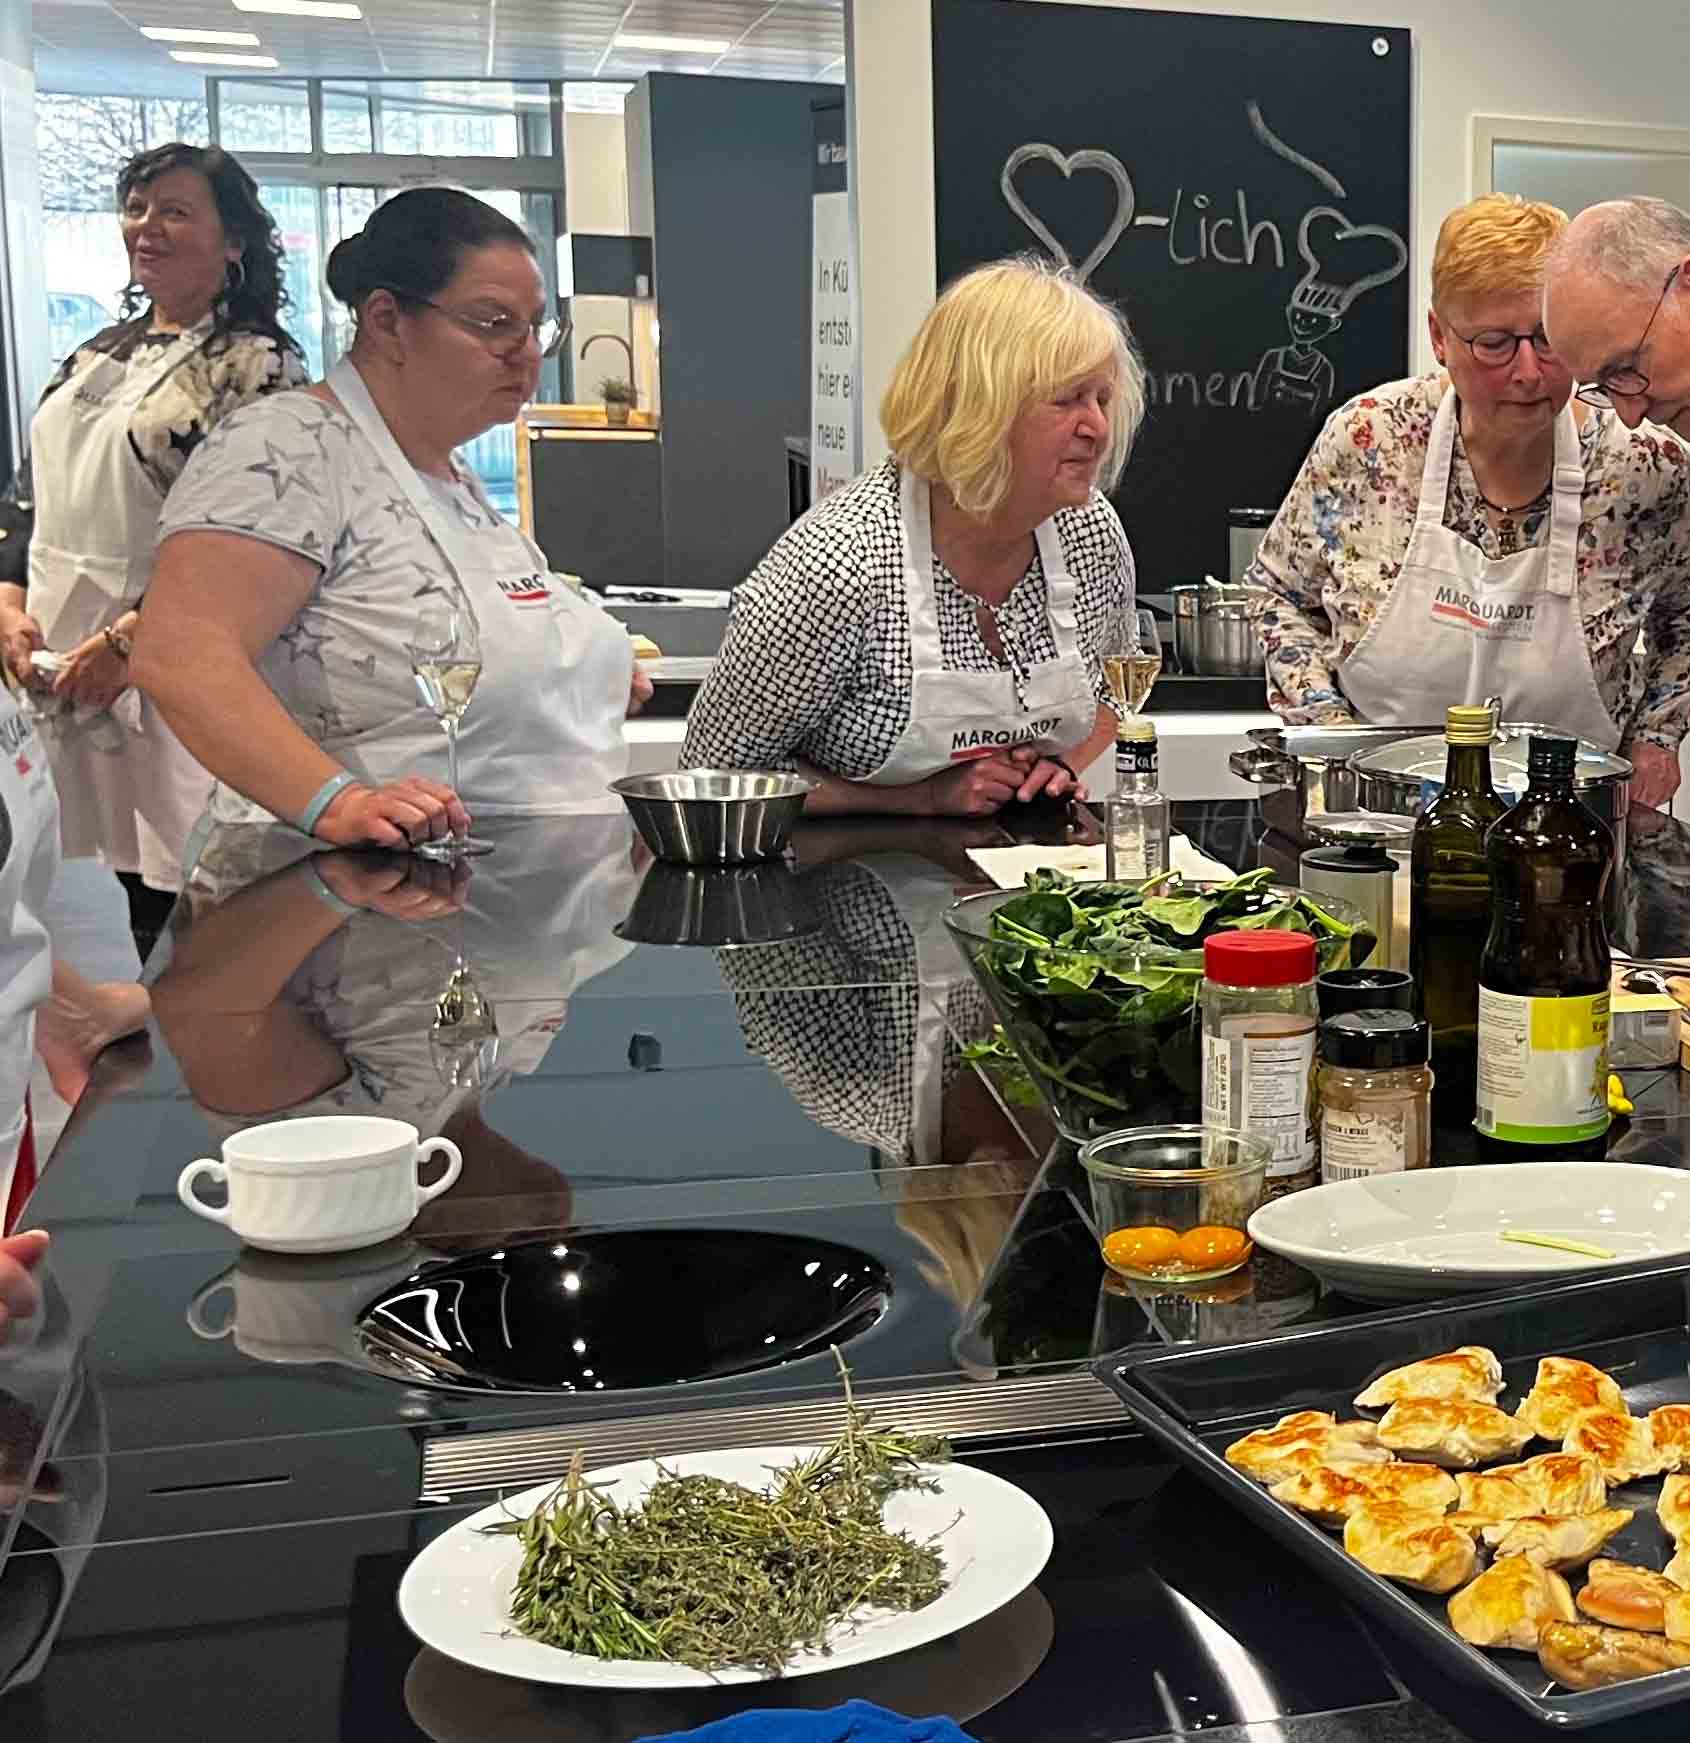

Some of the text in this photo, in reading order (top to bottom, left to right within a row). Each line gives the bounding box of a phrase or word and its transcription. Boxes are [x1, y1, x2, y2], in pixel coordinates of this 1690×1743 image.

[818, 318, 853, 346] entst
[817, 363, 854, 399] hier e
[817, 423, 846, 451] neue
[951, 717, 1062, 749] MARQUARDT
